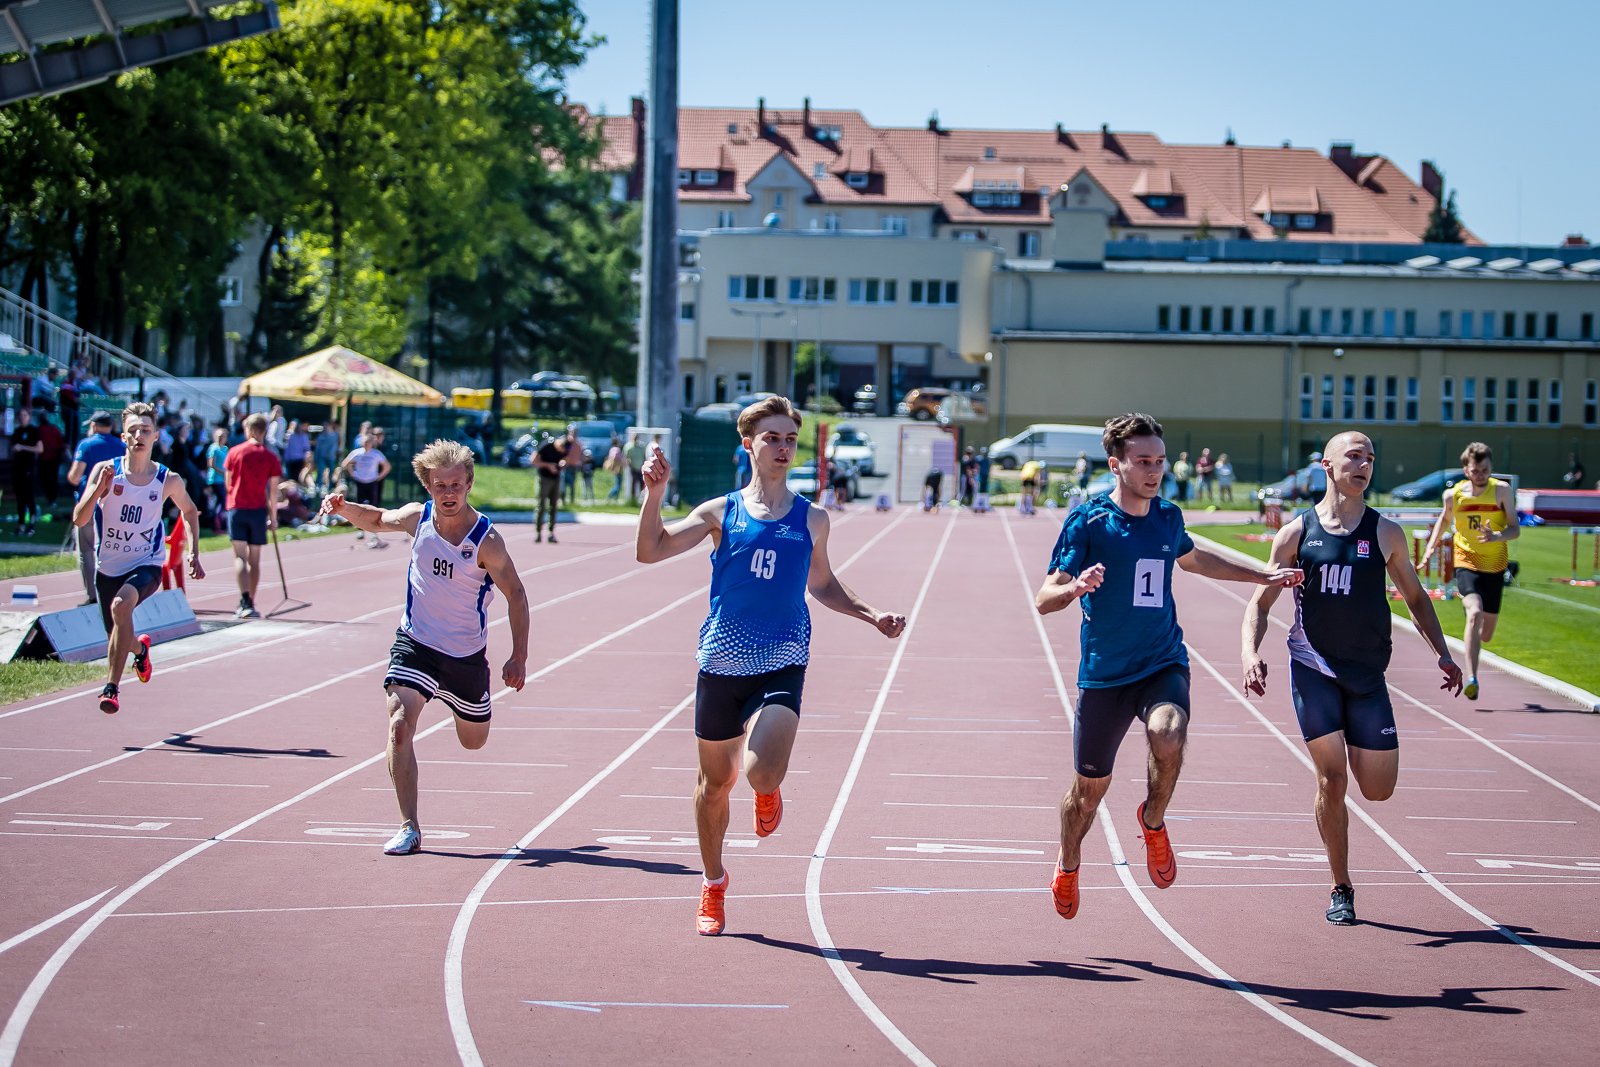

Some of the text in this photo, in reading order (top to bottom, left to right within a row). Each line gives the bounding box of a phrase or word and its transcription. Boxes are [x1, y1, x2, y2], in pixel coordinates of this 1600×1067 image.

[120, 504, 143, 524] 960
[107, 527, 134, 541] SLV
[432, 557, 454, 580] 991
[750, 548, 777, 580] 43
[1141, 571, 1155, 597] 1
[1319, 563, 1353, 595] 144
